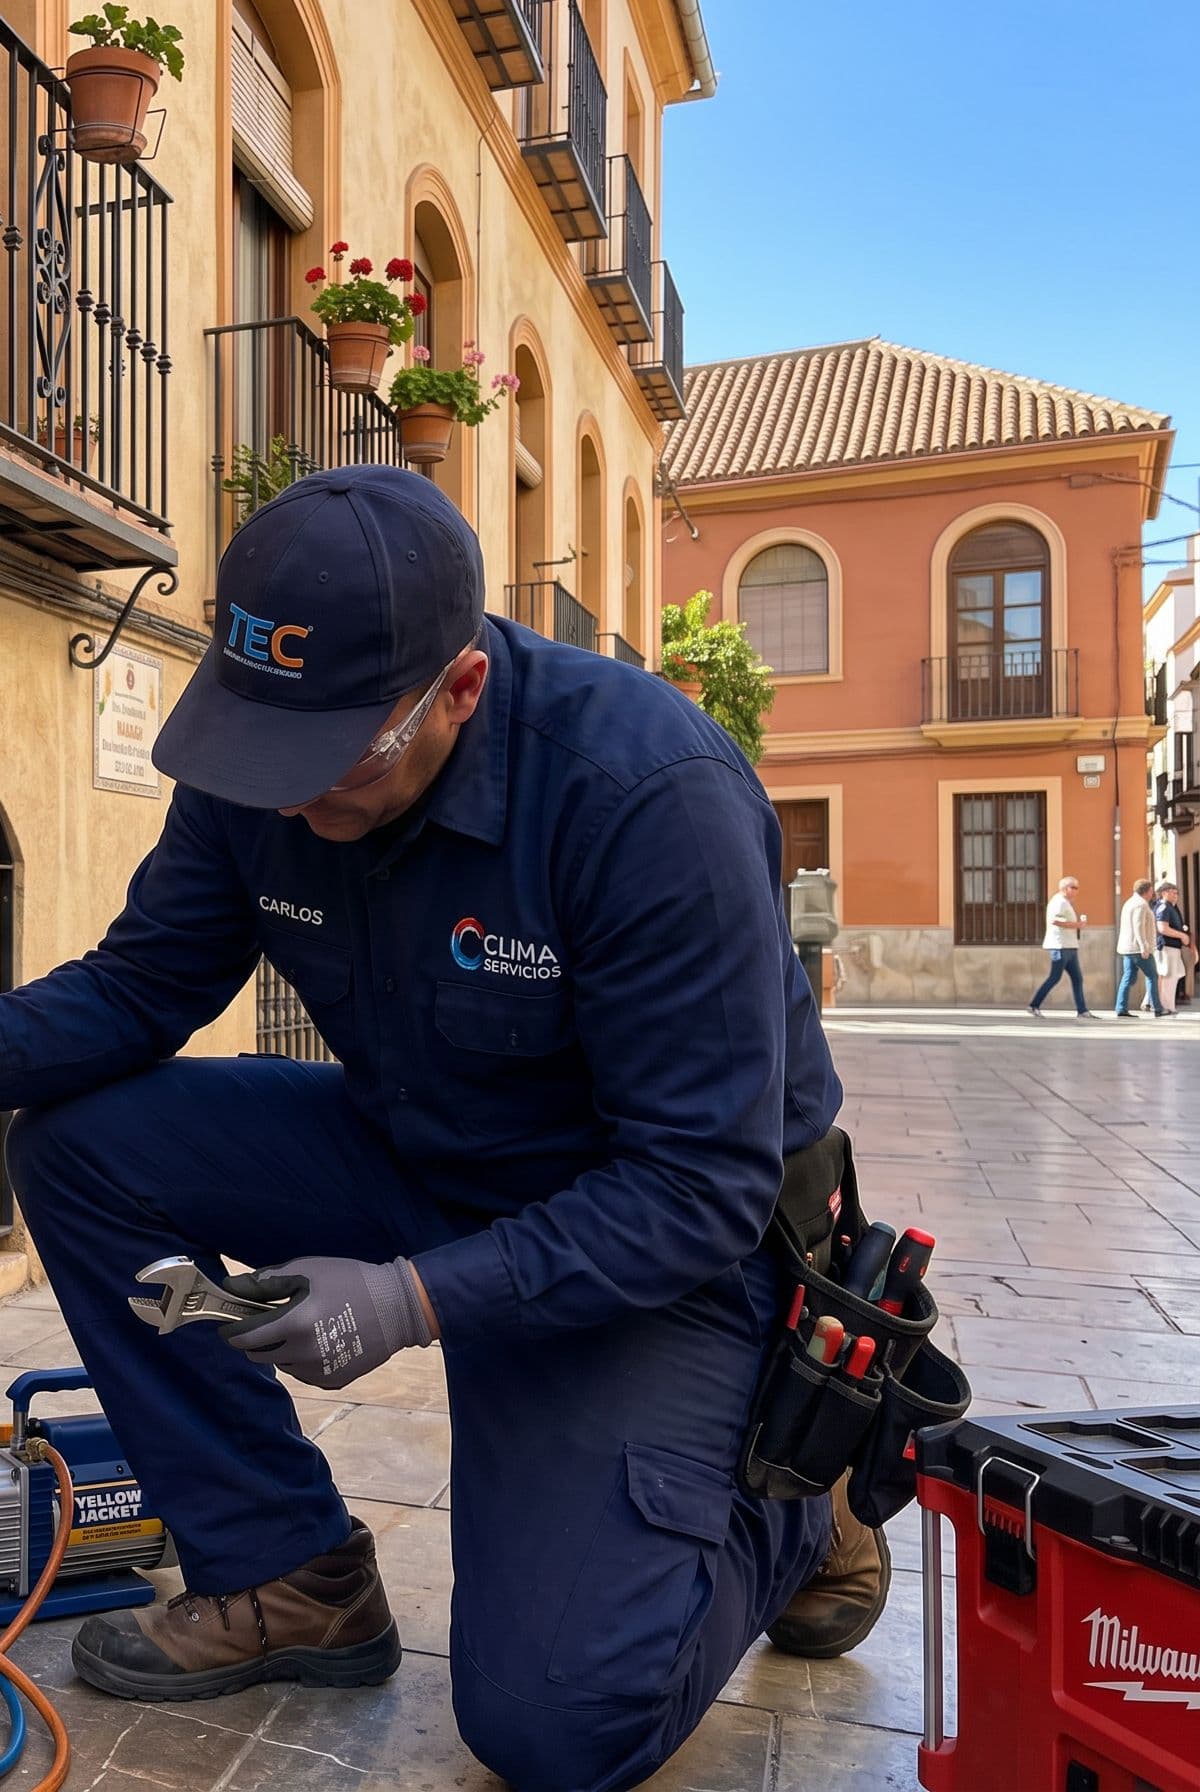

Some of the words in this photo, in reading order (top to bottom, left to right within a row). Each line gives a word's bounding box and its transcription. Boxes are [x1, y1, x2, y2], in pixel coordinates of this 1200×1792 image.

[228, 602, 309, 668] TEC
[259, 895, 324, 926] CARLOS
[483, 934, 558, 965] CLIMA
[483, 958, 562, 980] SERVICIOS
[74, 1489, 142, 1510] YELLOW
[78, 1503, 141, 1524] JACKET
[1080, 1607, 1200, 1682] Milwau
